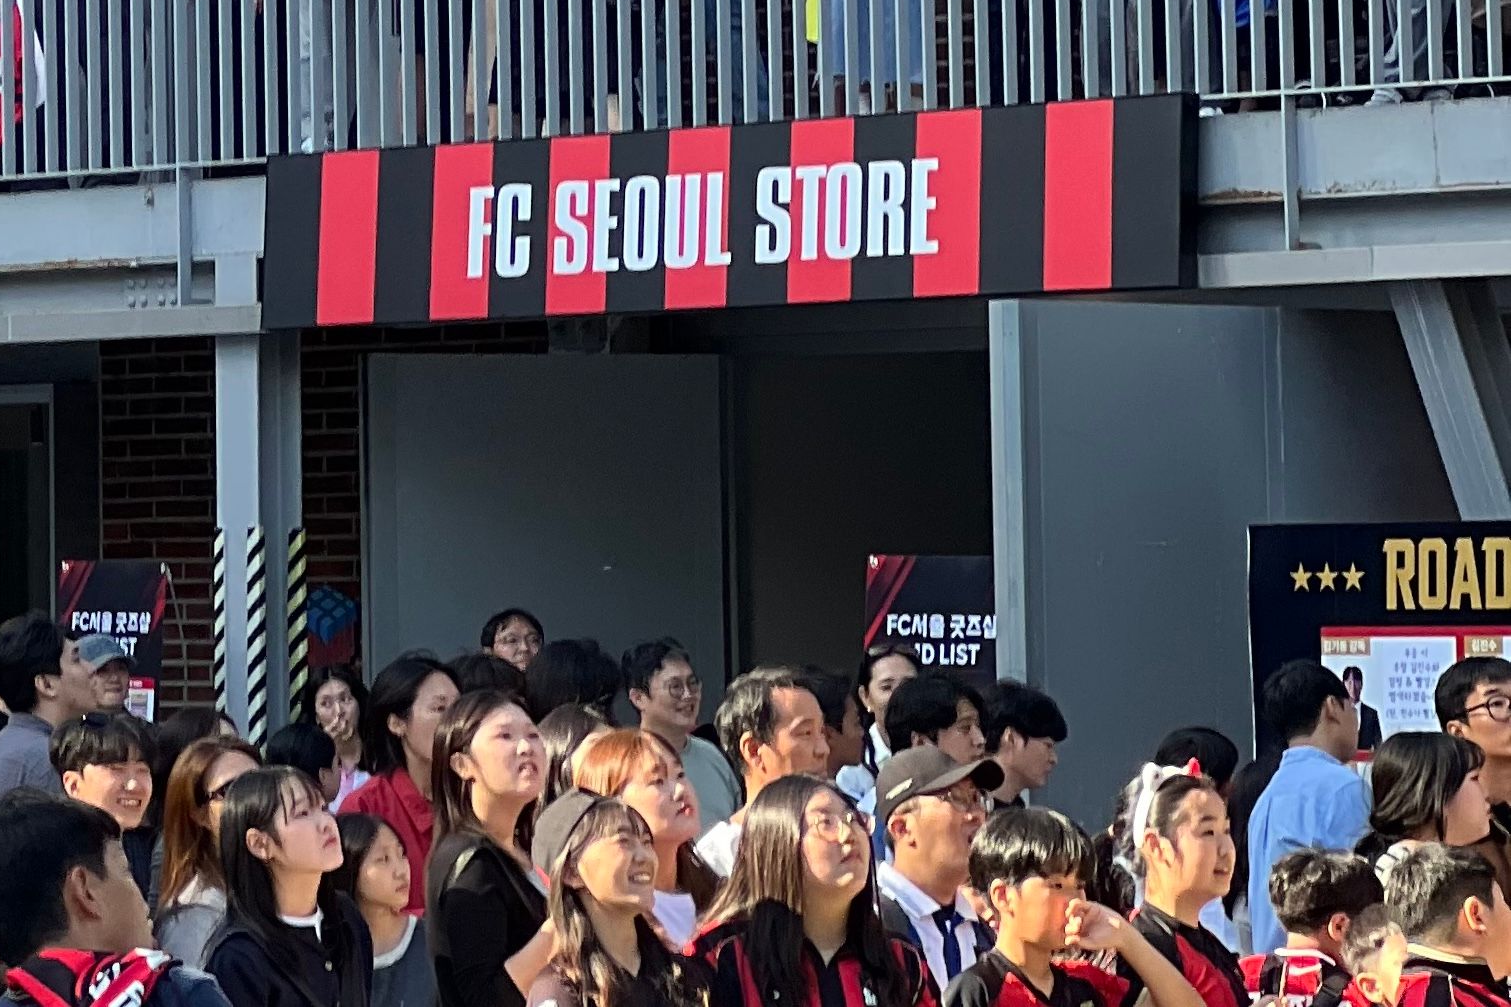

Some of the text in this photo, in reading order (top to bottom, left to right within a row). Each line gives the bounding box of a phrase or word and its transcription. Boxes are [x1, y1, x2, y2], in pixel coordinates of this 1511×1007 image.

[465, 157, 940, 280] FC SEOUL STORE
[1383, 535, 1511, 611] ROAD
[71, 610, 113, 633] FC서울
[886, 613, 945, 639] FC서울
[940, 643, 981, 666] LIST
